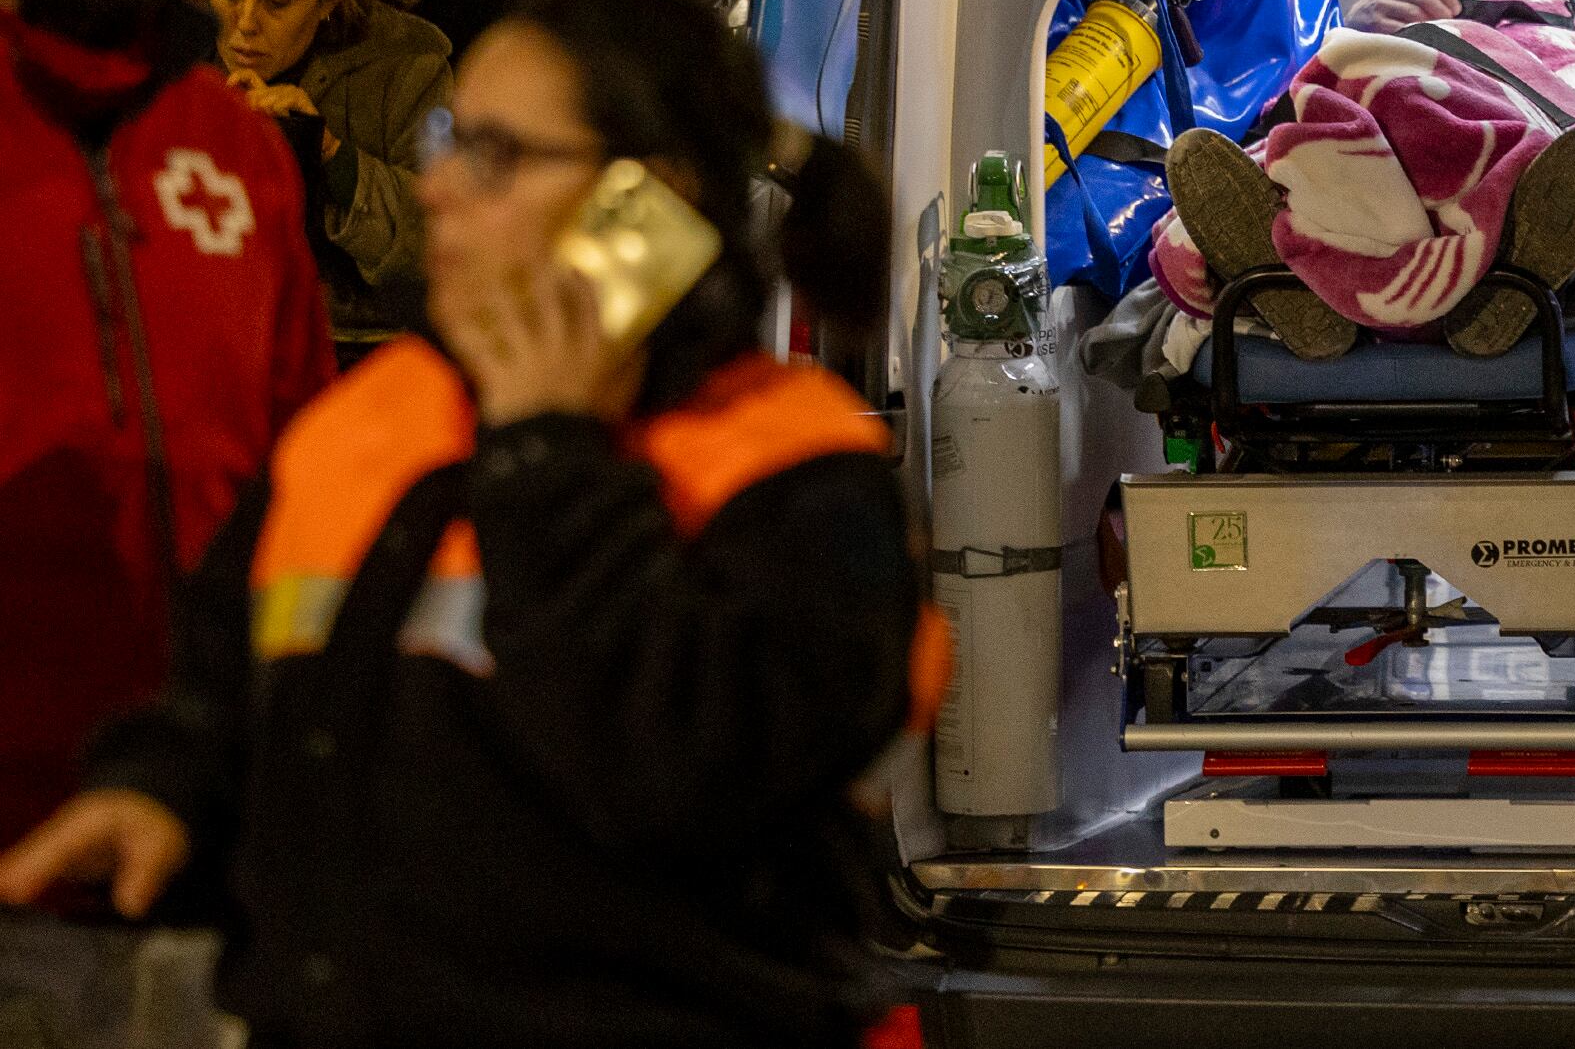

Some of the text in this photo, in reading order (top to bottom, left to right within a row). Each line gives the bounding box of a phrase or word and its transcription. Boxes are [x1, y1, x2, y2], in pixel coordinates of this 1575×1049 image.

[1211, 516, 1242, 540] 25
[1507, 559, 1561, 568] EMERGENCY
[1564, 559, 1570, 567] &
